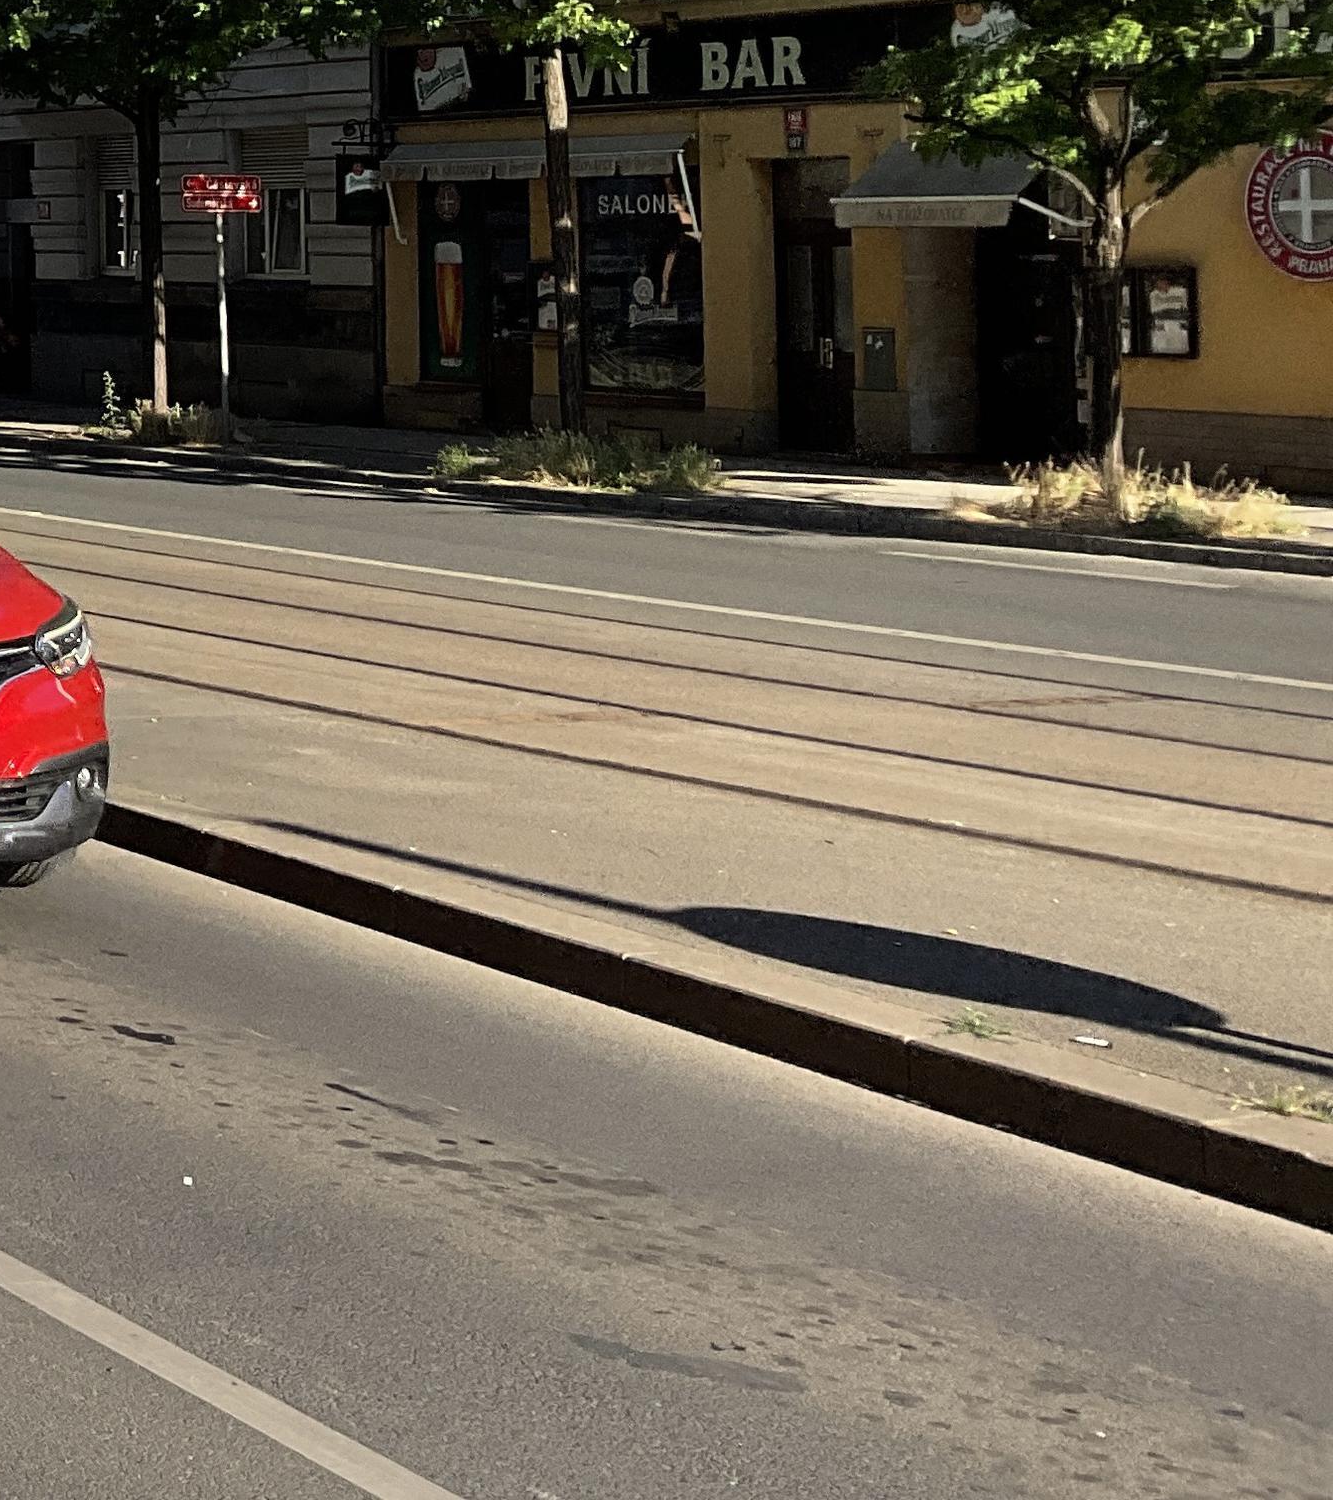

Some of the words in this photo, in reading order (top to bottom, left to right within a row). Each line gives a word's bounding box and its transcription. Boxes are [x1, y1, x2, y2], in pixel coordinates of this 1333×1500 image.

[523, 36, 651, 101] PVNÍ
[699, 36, 808, 91] BAR
[597, 192, 684, 215] SALONE
[1250, 145, 1294, 259] RESTAURAC
